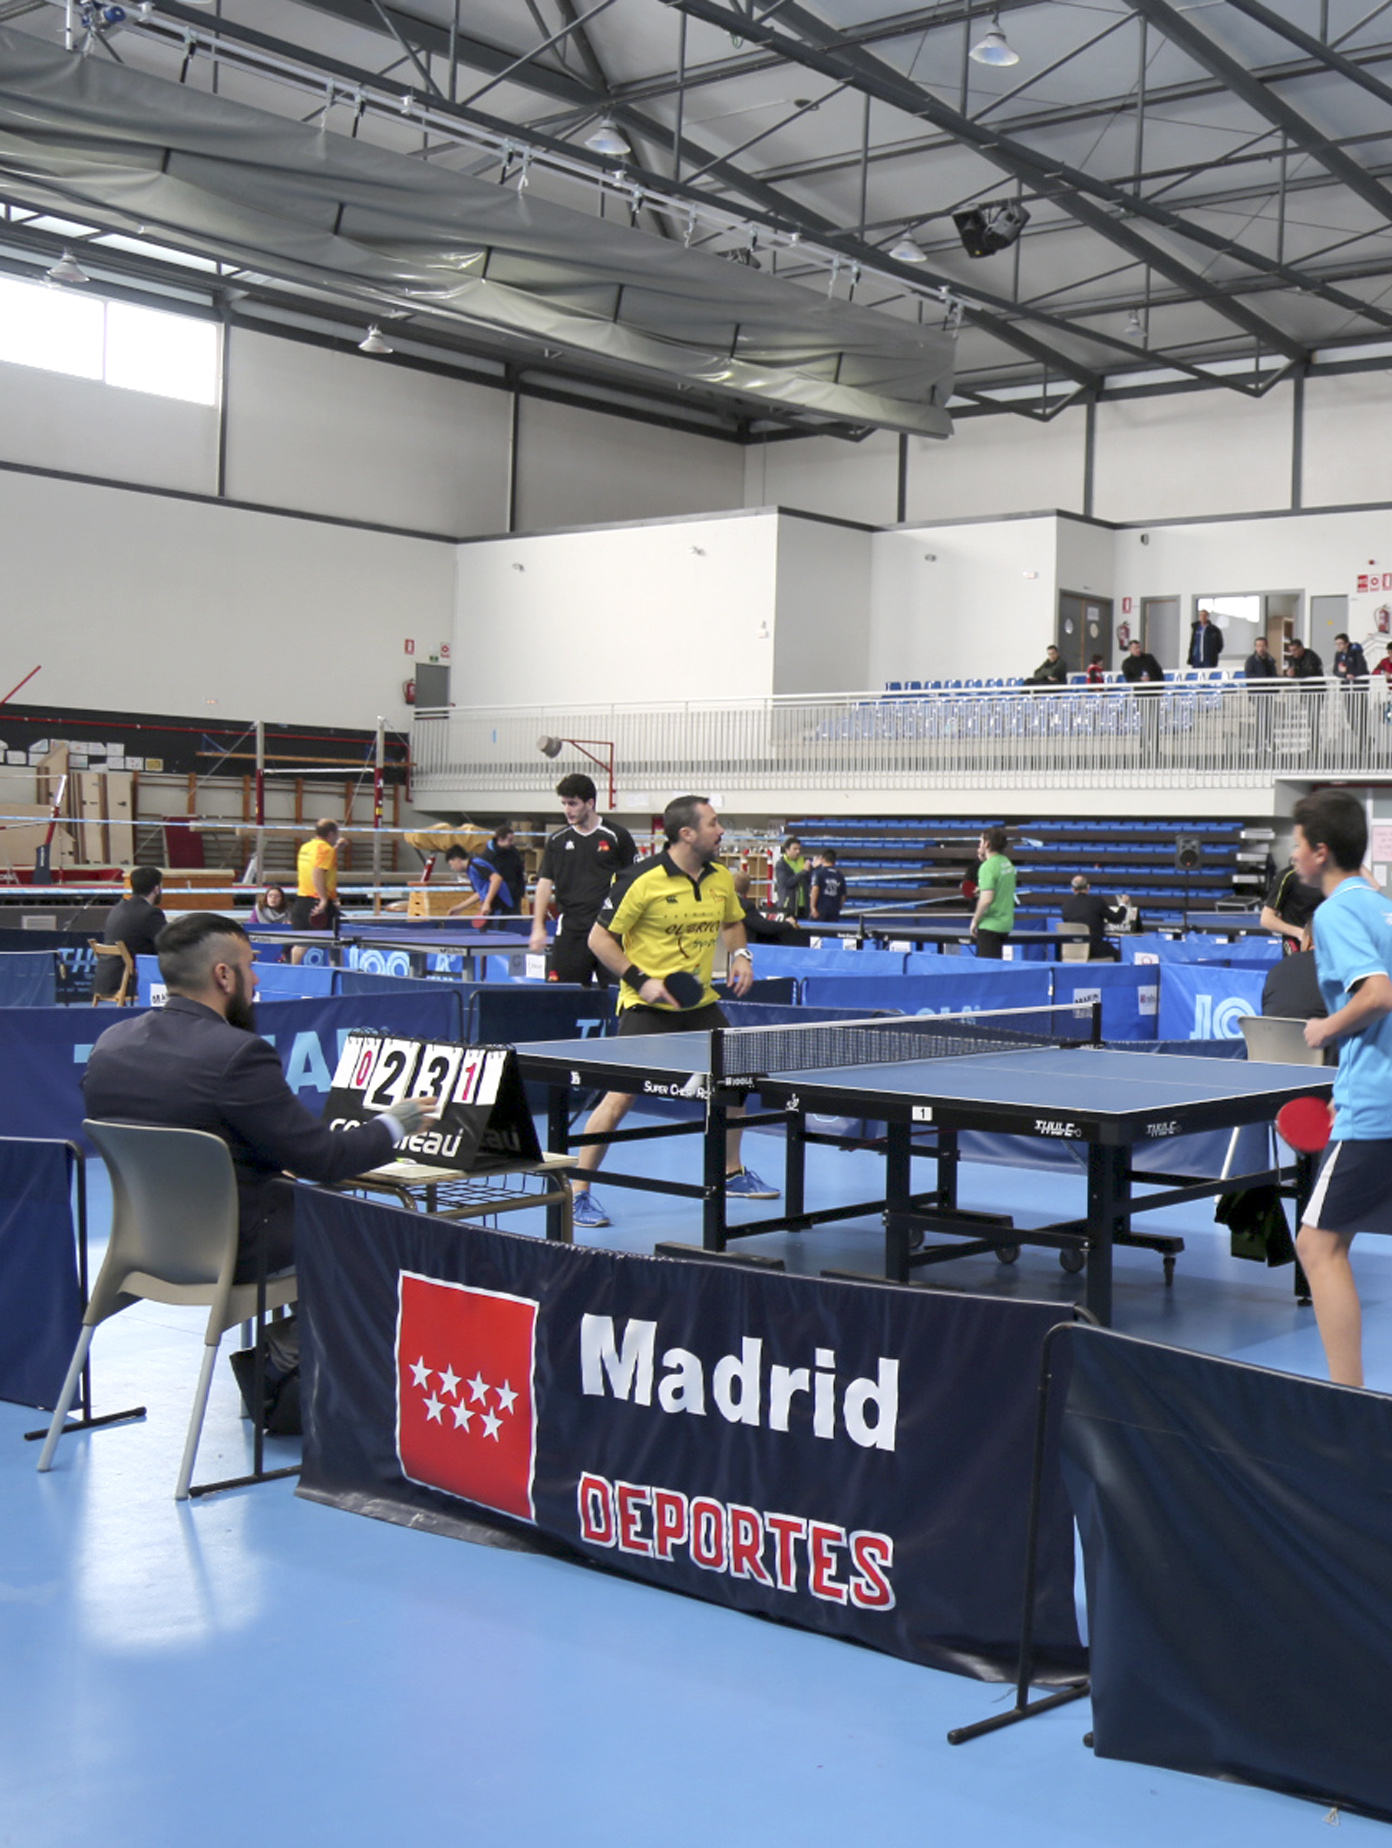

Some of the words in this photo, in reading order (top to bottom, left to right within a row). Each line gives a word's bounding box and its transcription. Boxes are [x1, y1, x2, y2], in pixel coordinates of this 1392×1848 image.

[356, 1050, 373, 1087] 0
[371, 1050, 407, 1105] 2
[419, 1056, 450, 1099] 3
[462, 1062, 477, 1101] 1
[643, 1080, 668, 1094] SUPER
[581, 1313, 898, 1452] Madrid
[577, 1471, 896, 1612] DEPORTES
